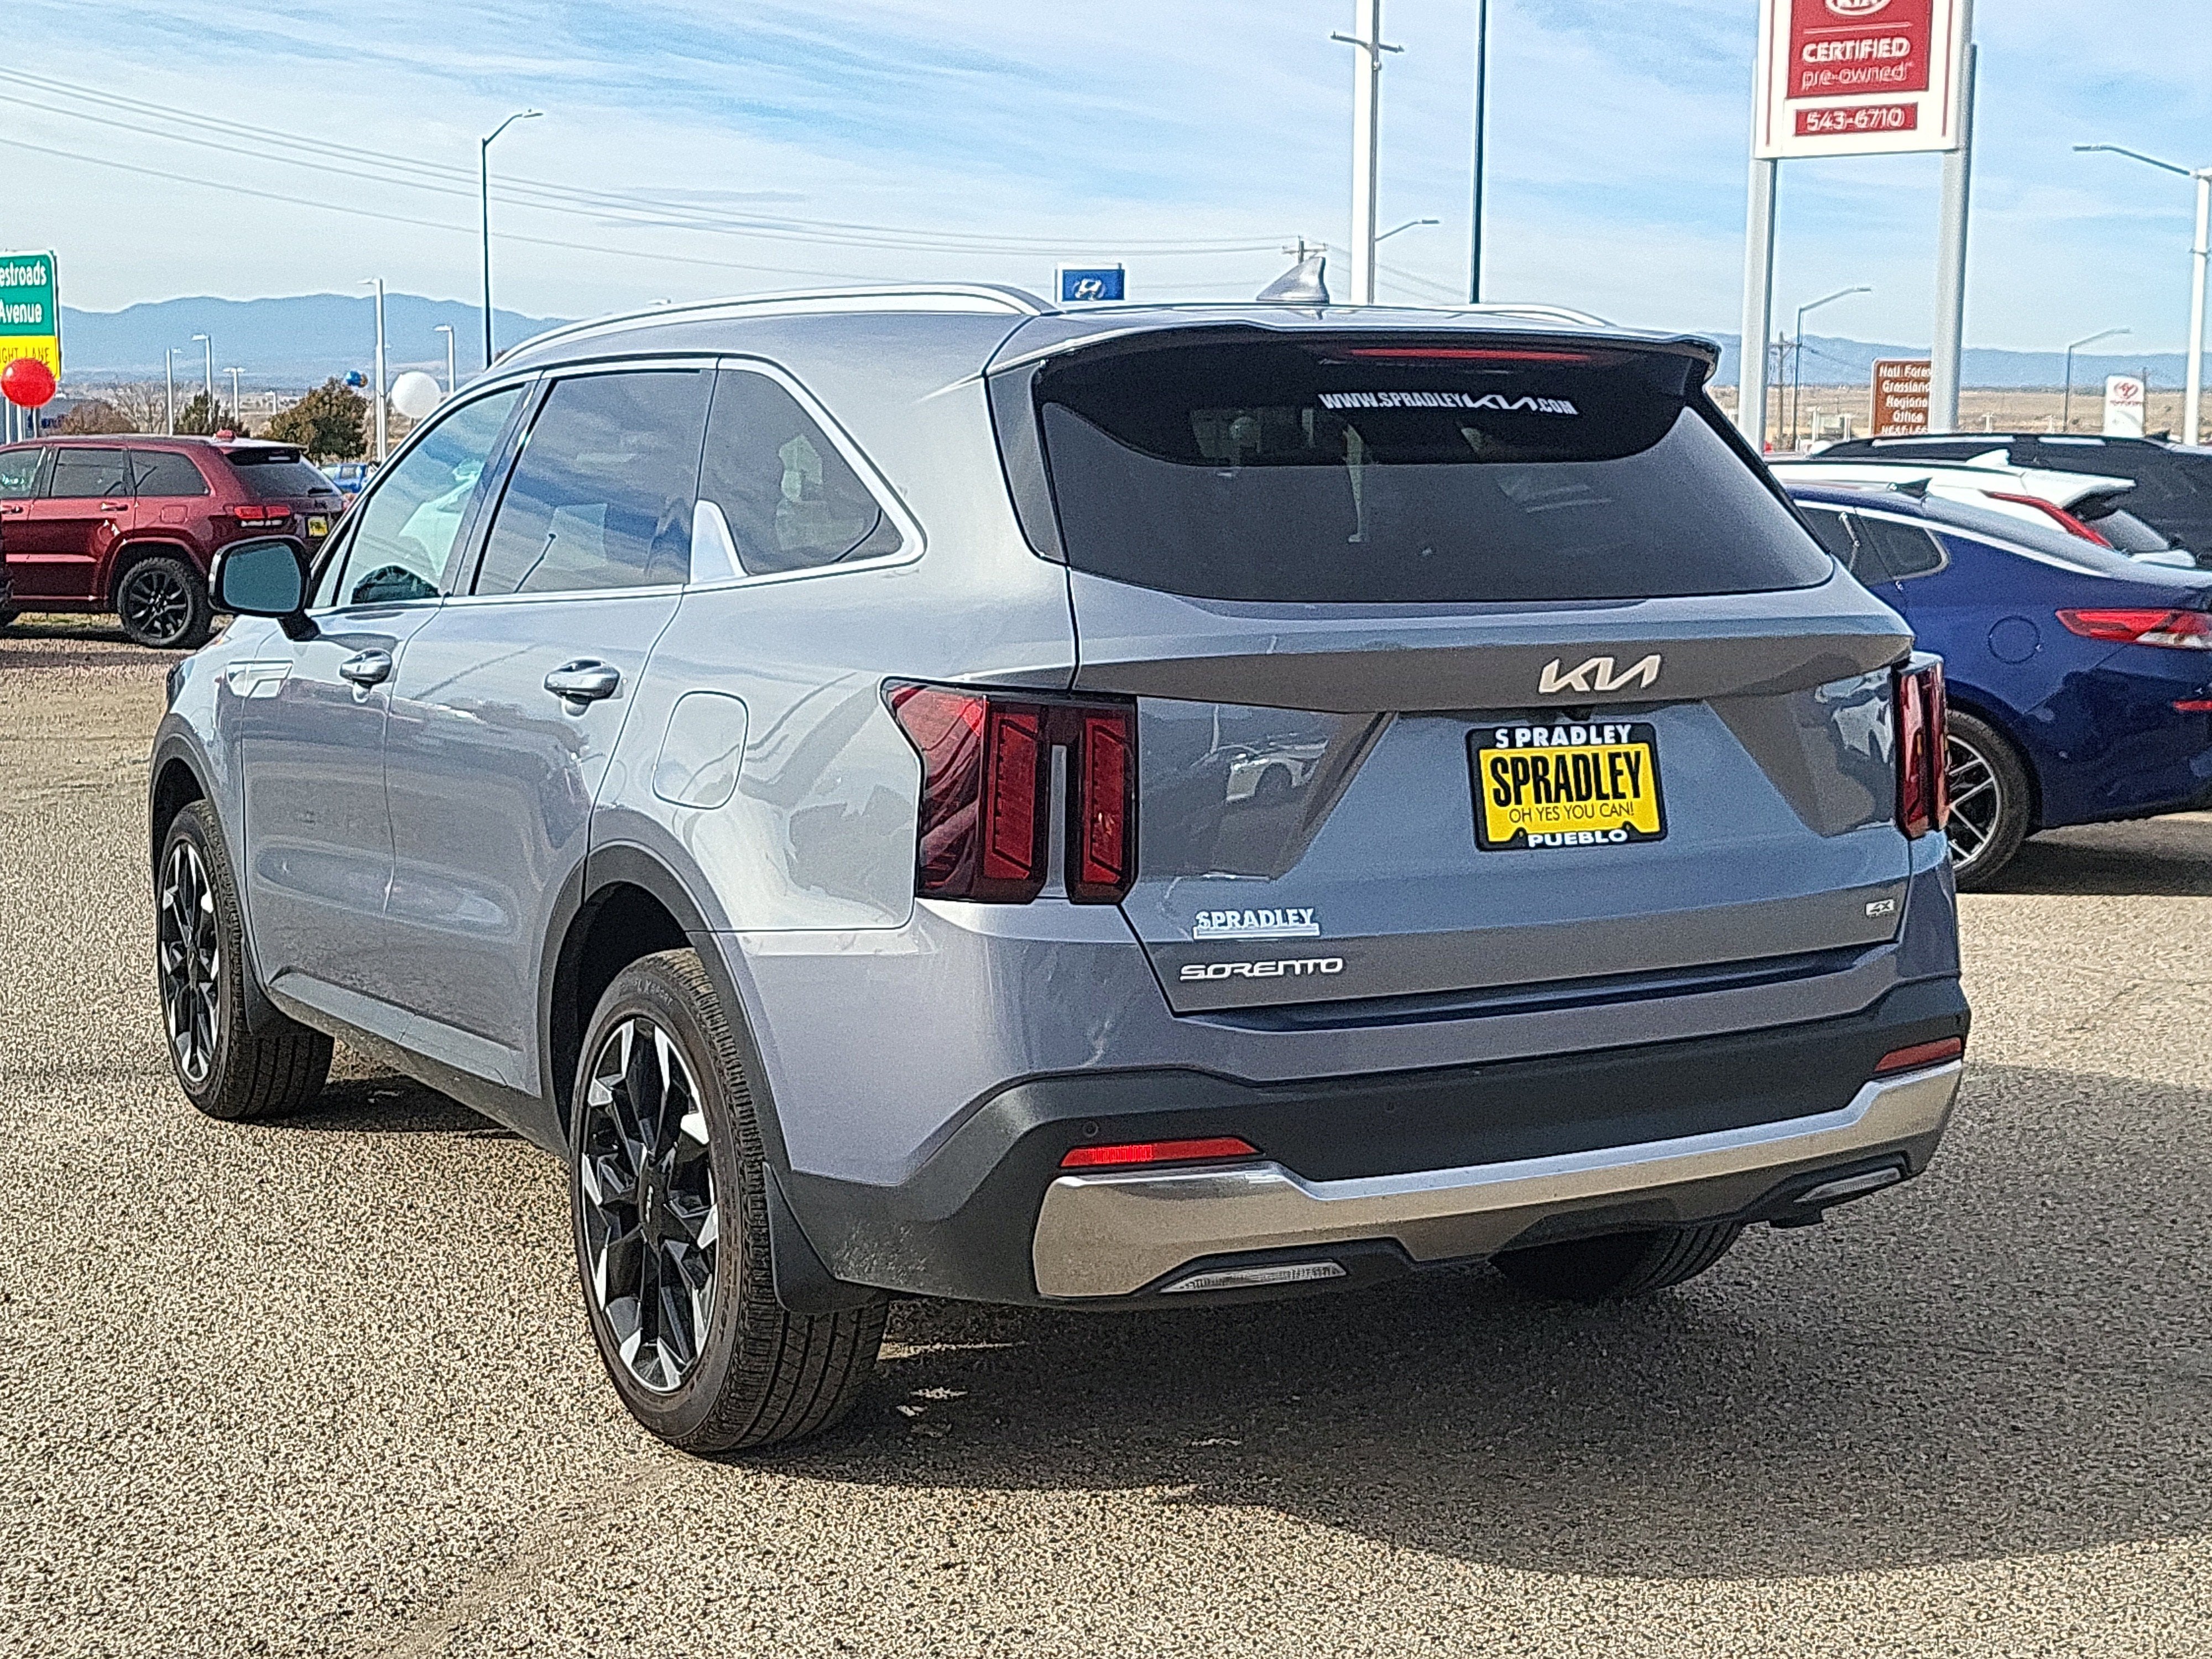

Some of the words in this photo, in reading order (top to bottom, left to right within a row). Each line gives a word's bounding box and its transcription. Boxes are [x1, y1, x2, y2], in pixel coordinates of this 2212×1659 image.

[1802, 37, 1911, 63] CERTIFIED
[1807, 107, 1905, 132] 543-6710
[0, 299, 42, 324] Avenue
[1892, 409, 1925, 424] Office
[1538, 653, 1661, 695] KIA
[1490, 750, 1642, 808] SPRADLEY
[1509, 808, 1532, 823] OH
[1536, 806, 1560, 822] YES
[1563, 804, 1595, 820] YOU
[1599, 801, 1635, 818] CAN!
[1527, 829, 1629, 848] PUEBLO
[1195, 908, 1314, 930] SPRADLEY
[1180, 958, 1343, 981] SORENTO
